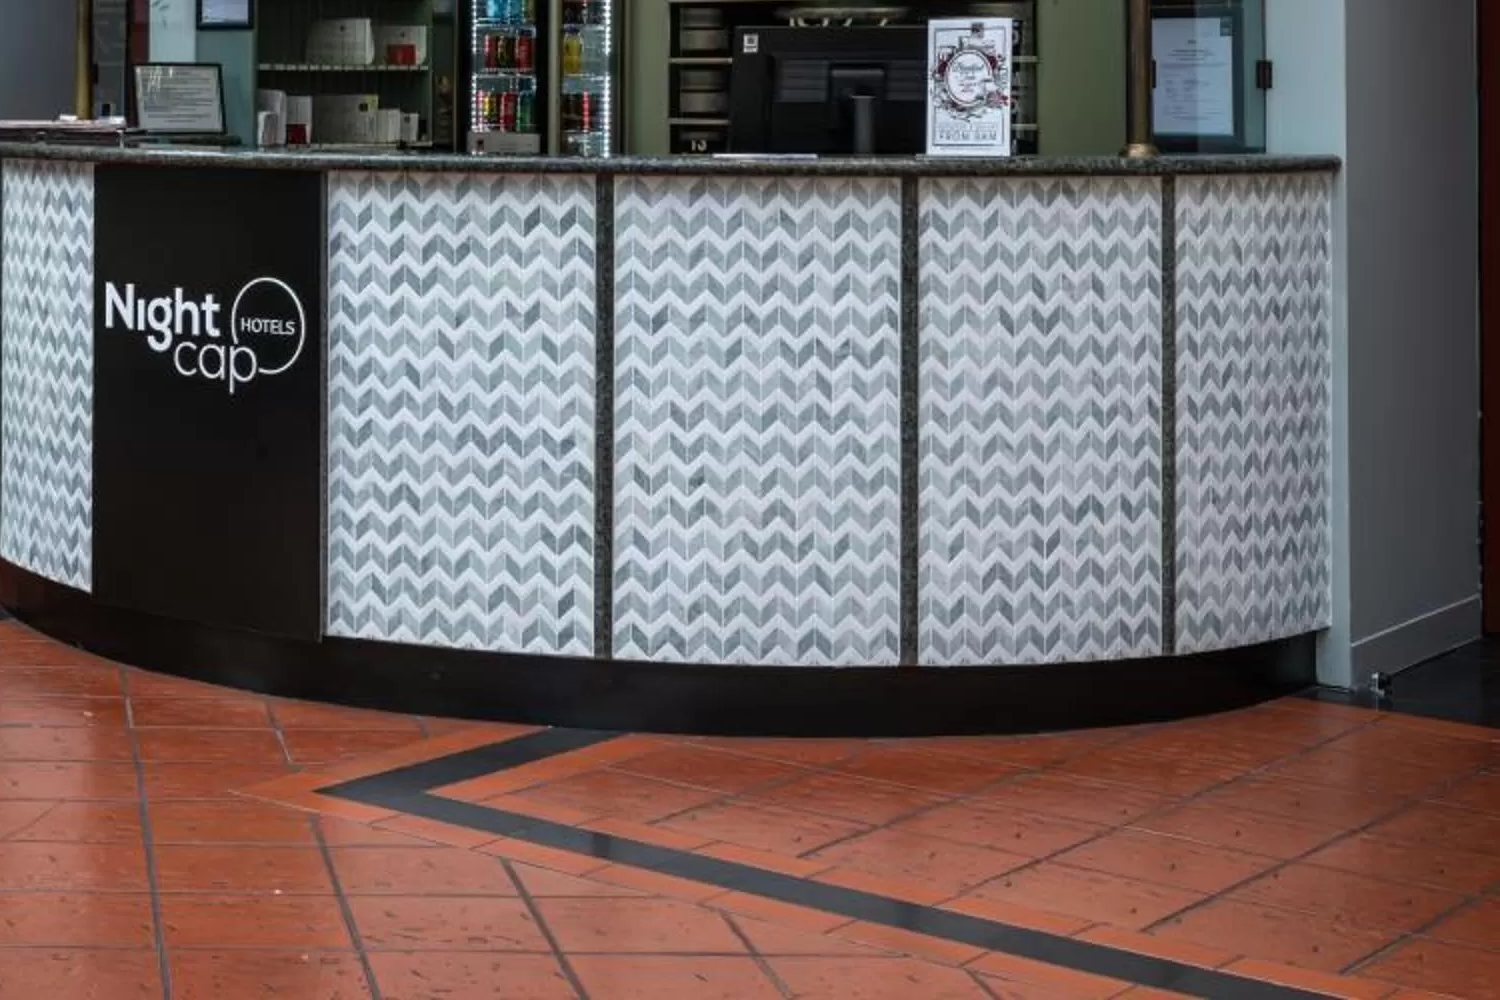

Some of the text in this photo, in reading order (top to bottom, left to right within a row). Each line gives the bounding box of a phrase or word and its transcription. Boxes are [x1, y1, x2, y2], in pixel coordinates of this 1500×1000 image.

[105, 281, 221, 352] Night
[240, 317, 296, 336] HOTELS
[173, 341, 257, 395] cap
